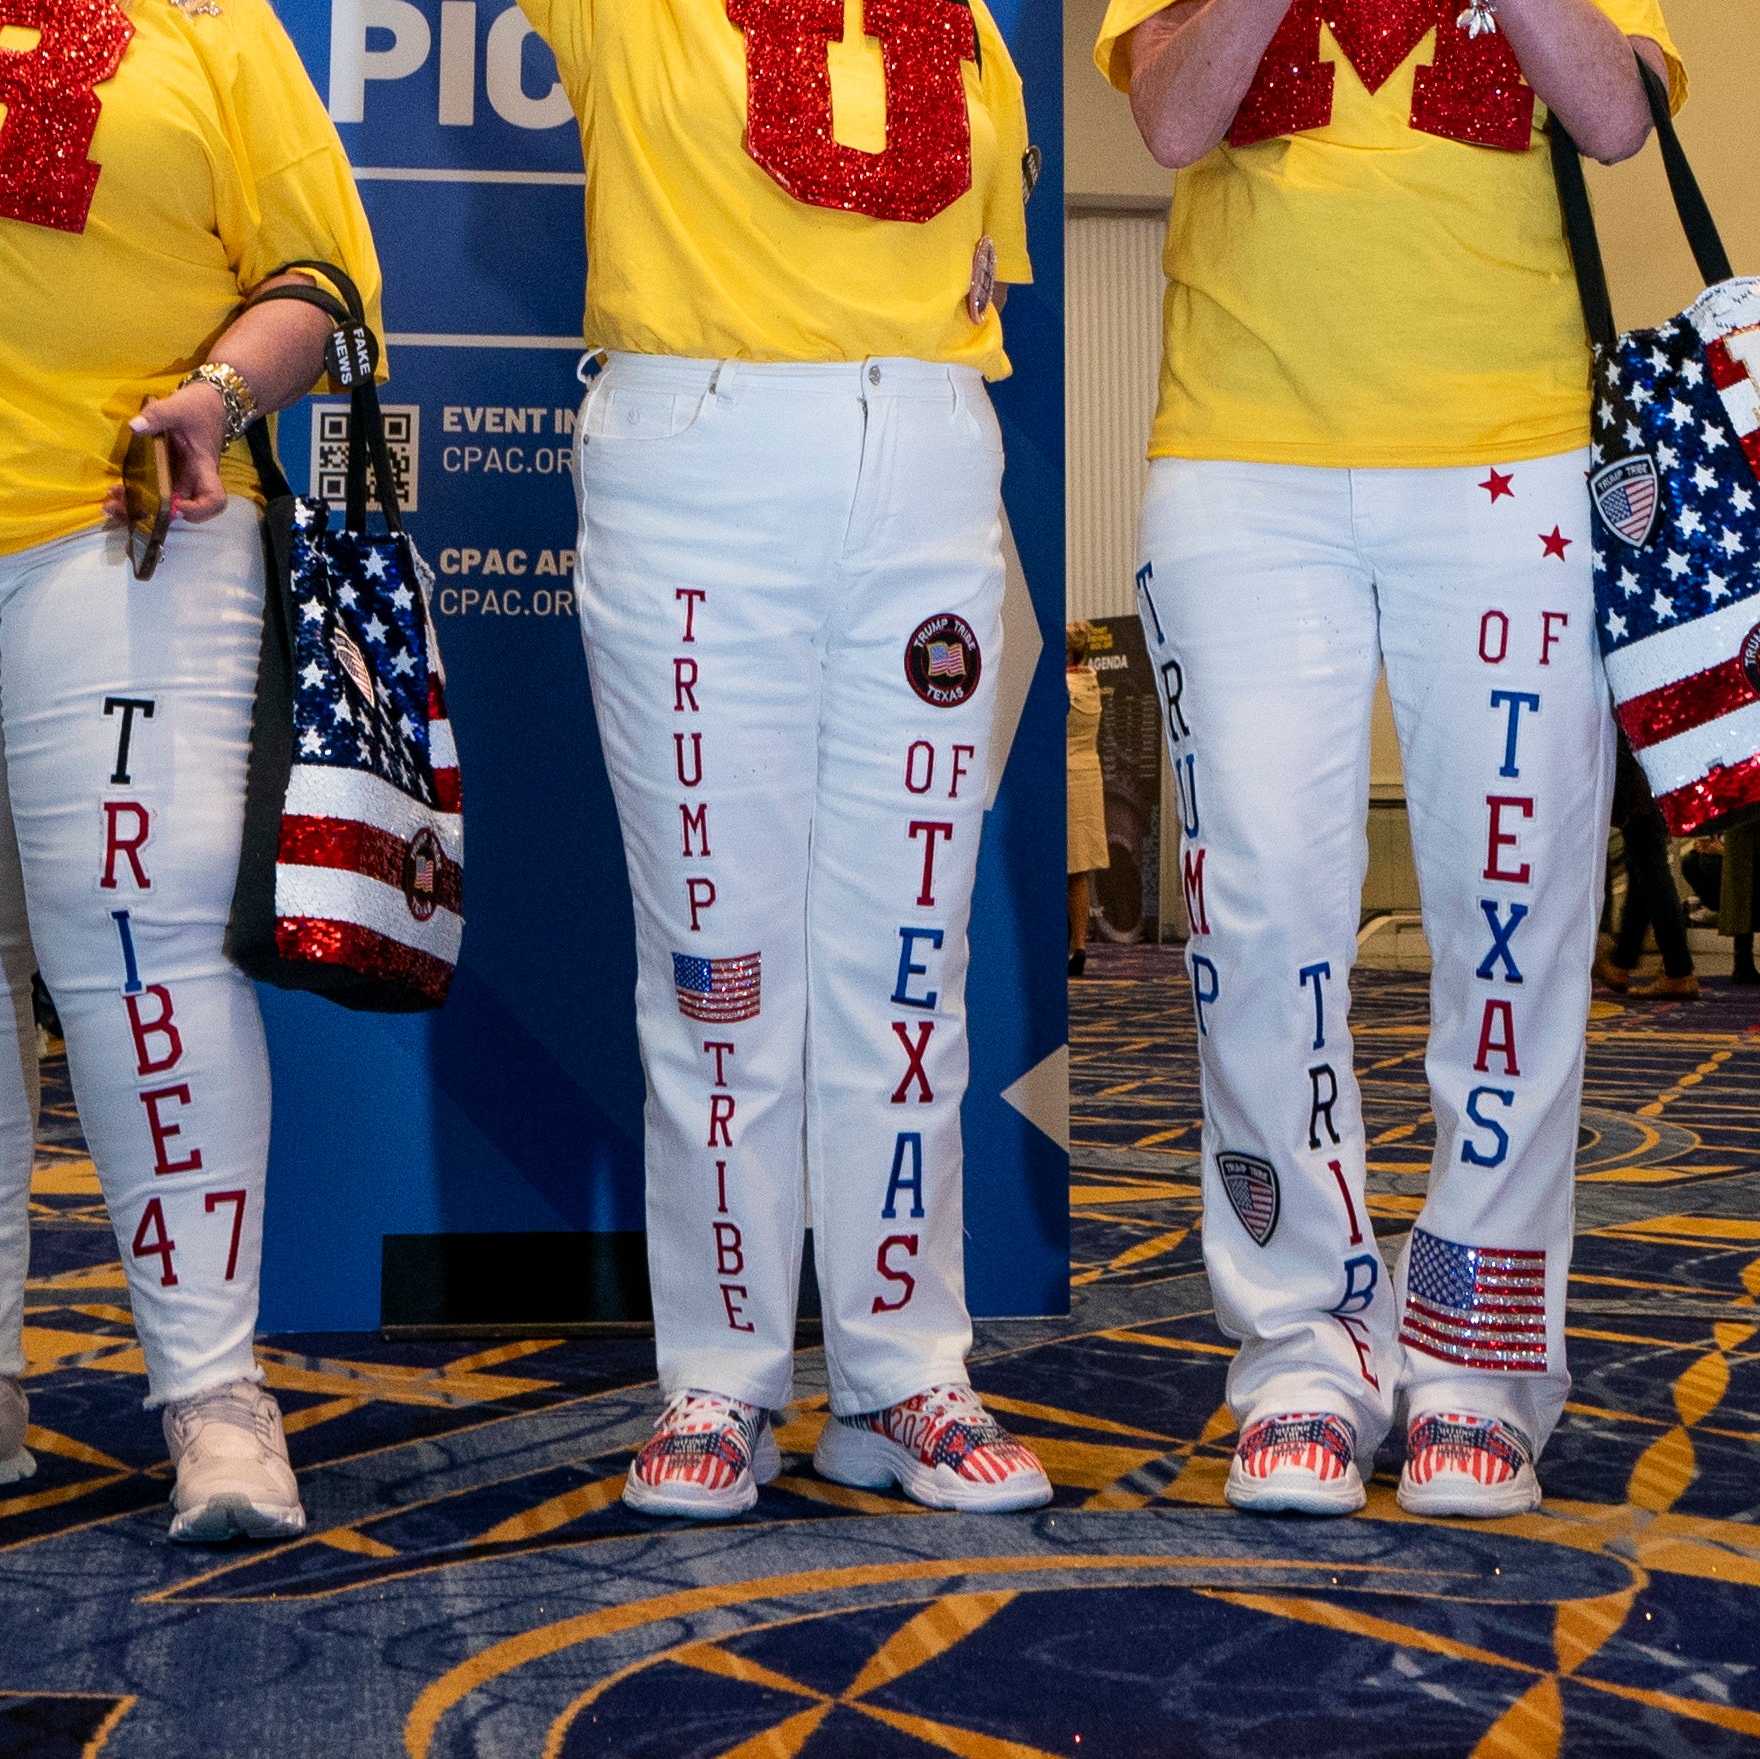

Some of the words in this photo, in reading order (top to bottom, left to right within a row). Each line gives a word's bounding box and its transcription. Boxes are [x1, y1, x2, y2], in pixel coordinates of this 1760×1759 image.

[333, 331, 353, 385] NEWS
[353, 327, 371, 376] FAKE
[443, 406, 547, 434] EVENT
[554, 408, 580, 435] IN
[443, 447, 574, 474] CPAC.OR
[439, 548, 527, 575] CPAC
[535, 550, 576, 576] AP
[439, 589, 580, 617] CPAC.OR
[913, 618, 948, 648] TRUMP
[953, 620, 977, 652] TRIBE
[1479, 609, 1568, 665] OF
[1088, 655, 1128, 670] AGENDA
[926, 683, 964, 702] TEXAS
[905, 740, 975, 798] OF
[1135, 562, 1219, 1036] TRUMP
[100, 696, 202, 1175] TRIBE
[1461, 690, 1540, 1167] TEXAS
[674, 588, 716, 931] TRUMP
[703, 1041, 755, 1332] TRIBE
[872, 821, 952, 1313] TEXAS
[132, 1188, 247, 1286] 47
